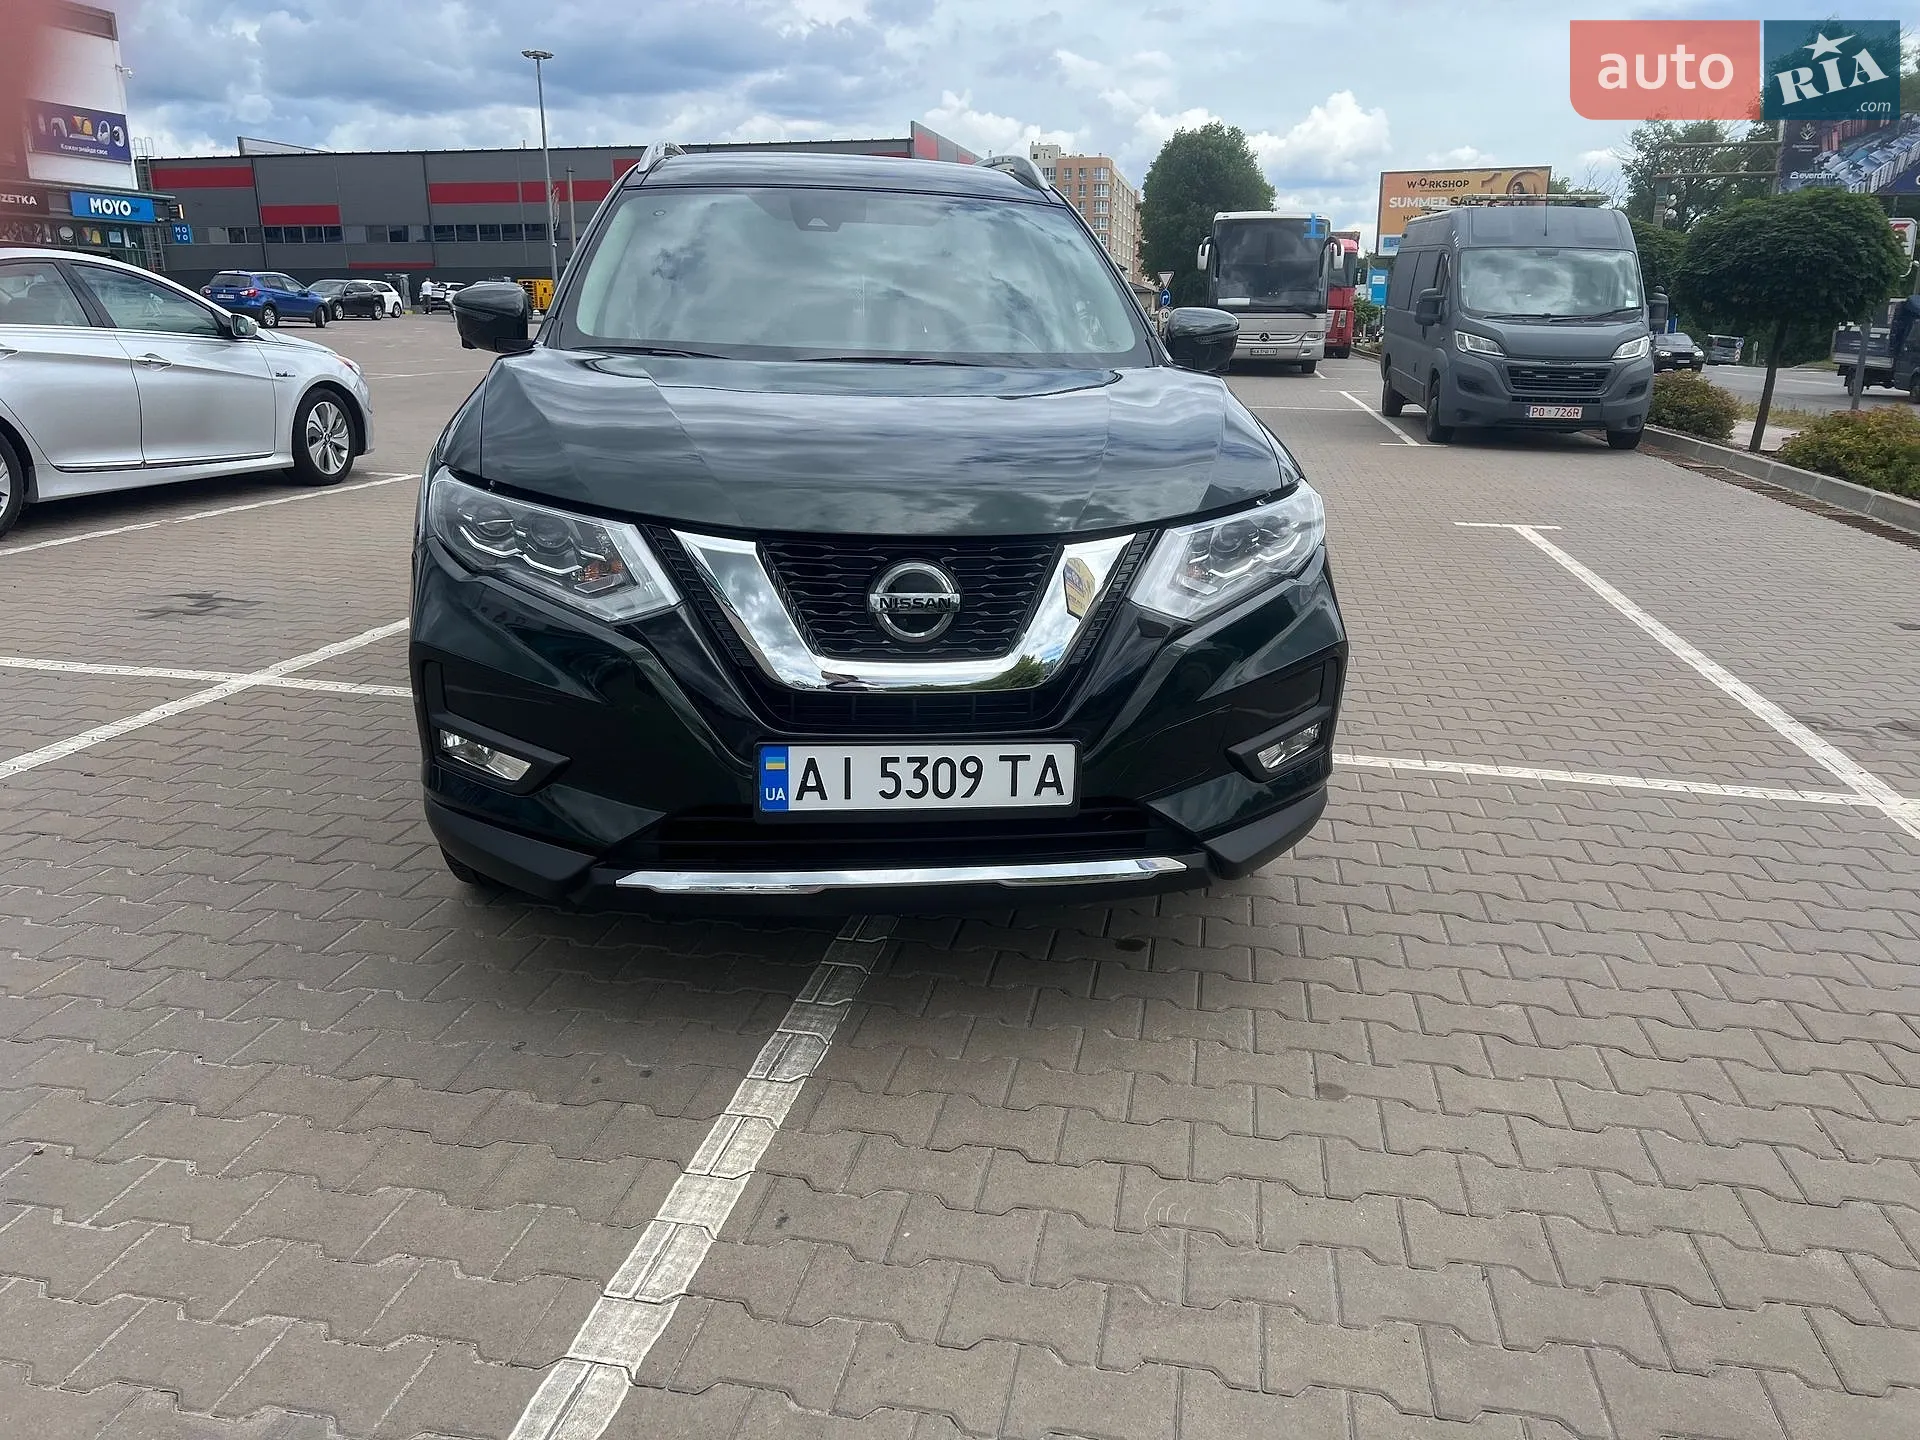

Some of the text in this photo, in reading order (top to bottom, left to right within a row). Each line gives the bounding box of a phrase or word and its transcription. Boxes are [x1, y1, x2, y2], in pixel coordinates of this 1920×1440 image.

[90, 197, 132, 216] MOYO
[1389, 196, 1448, 208] SUMMER
[1554, 408, 1580, 417] 726R
[879, 597, 951, 609] NISSAN
[796, 754, 1064, 801] AI 5309 TA
[765, 787, 786, 801] UA
